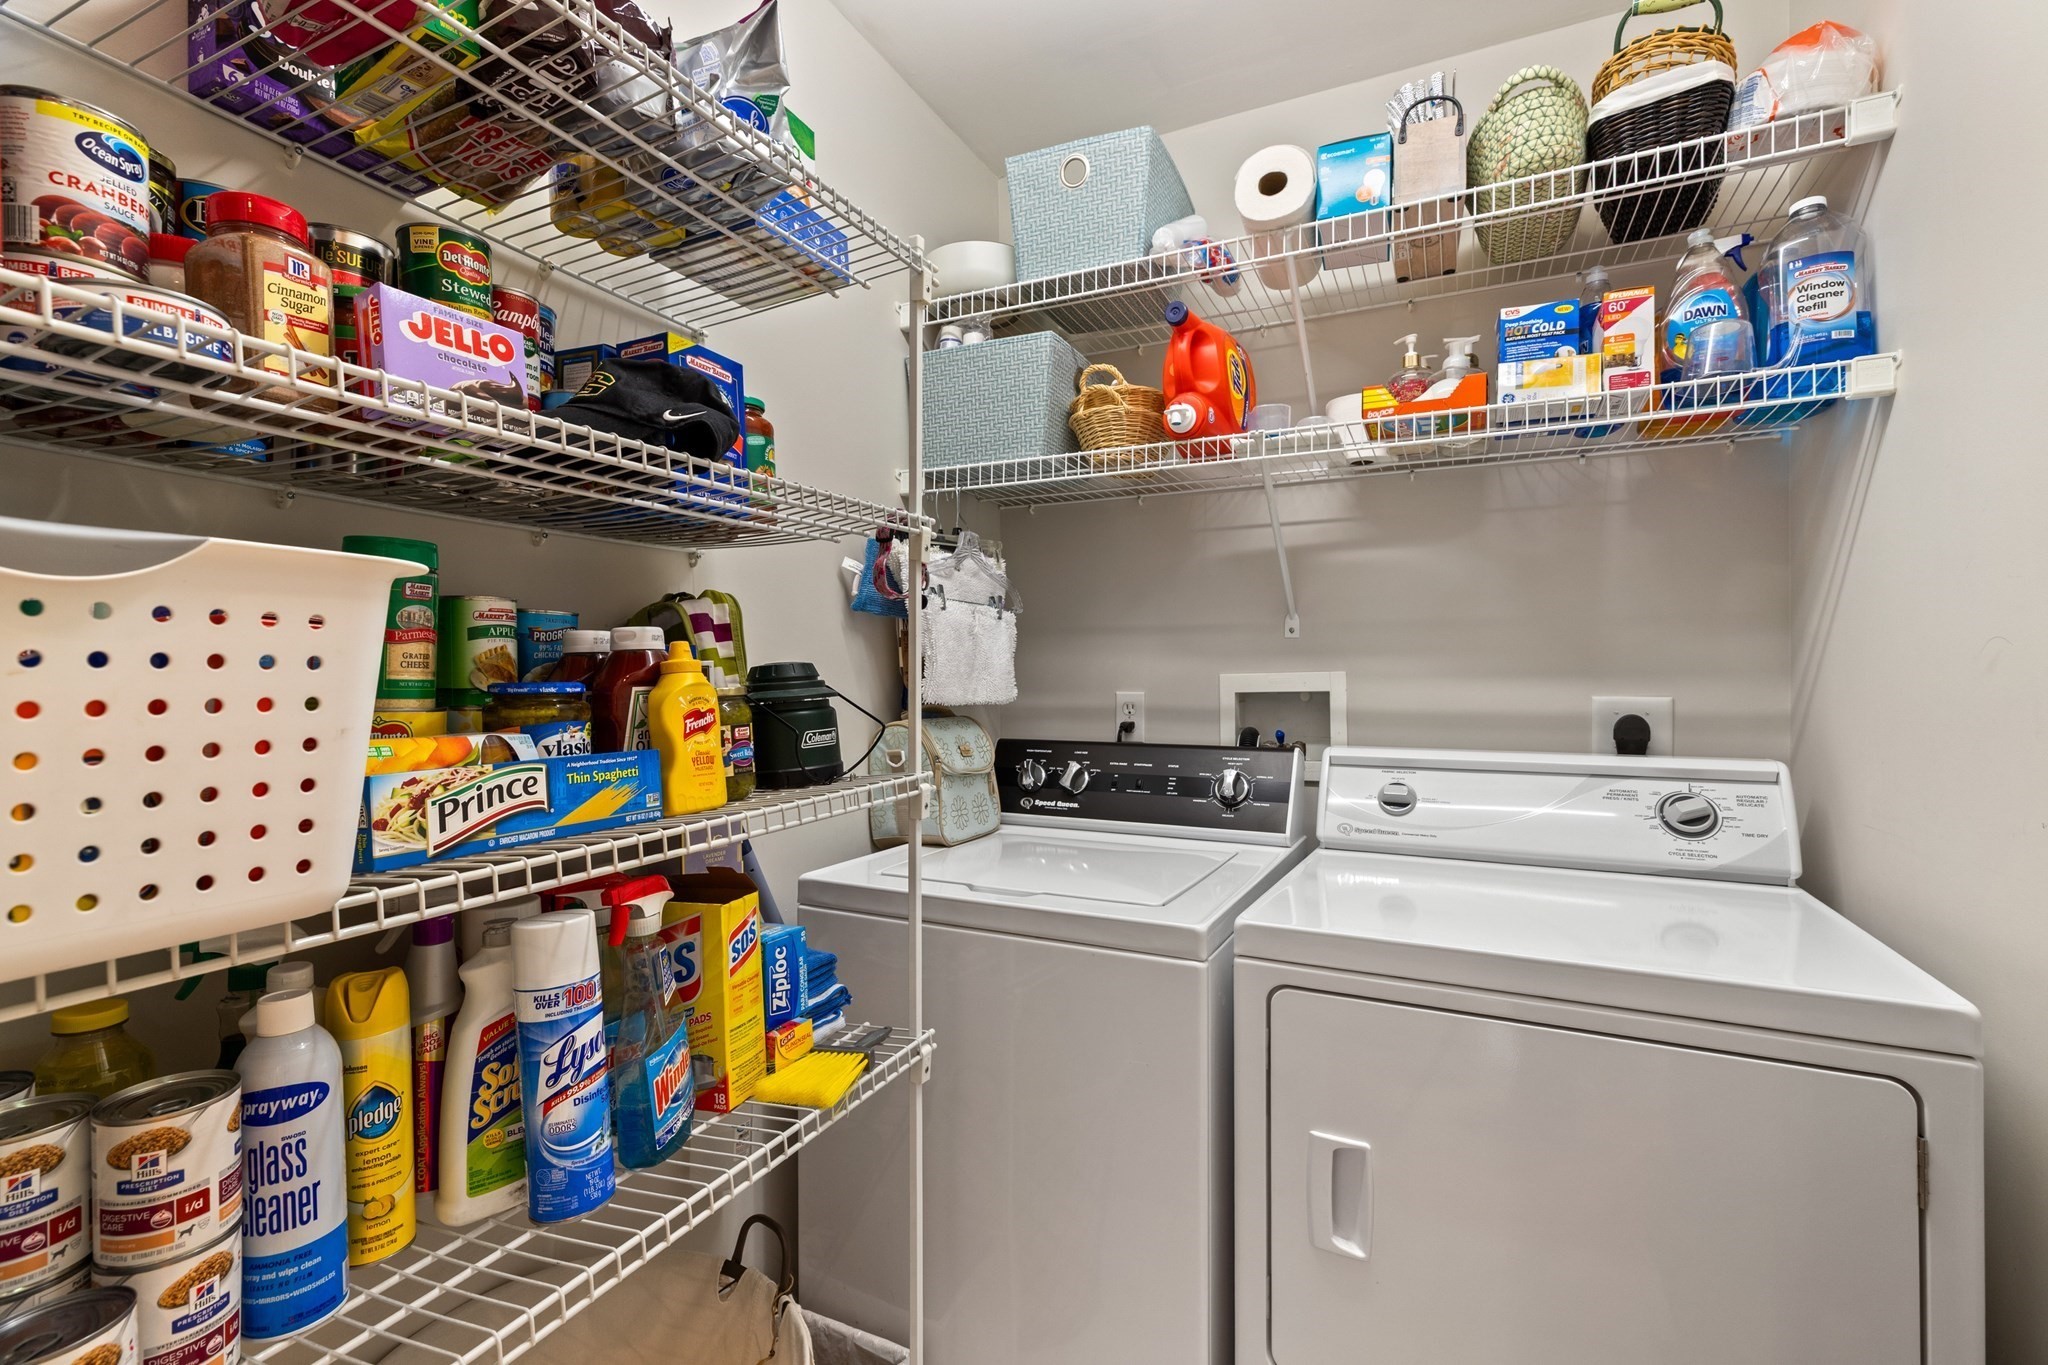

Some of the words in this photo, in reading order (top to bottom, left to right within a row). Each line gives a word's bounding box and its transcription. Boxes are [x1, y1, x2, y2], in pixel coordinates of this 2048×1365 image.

[73, 112, 90, 122] TRY
[93, 119, 122, 136] RECIPE
[82, 138, 119, 167] Ocean
[119, 156, 143, 178] Spray
[1327, 148, 1355, 158] ecosmart
[100, 175, 137, 197] JELLIED
[104, 202, 135, 221] SAUCE
[322, 246, 334, 260] le
[337, 250, 383, 276] SUEUR
[442, 250, 462, 264] Del
[462, 254, 490, 277] Monte
[284, 272, 314, 288] McCormick
[1796, 268, 1823, 277] MARKET
[268, 282, 326, 306] Cinnamon
[442, 278, 492, 306] Stewed
[1609, 288, 1648, 300] SYLVANIA
[1797, 280, 1845, 294] Window
[1797, 290, 1844, 304] Cleaner
[280, 297, 315, 314] Sugar
[1505, 308, 1520, 316] CVS
[1684, 304, 1728, 322] DAWN
[1797, 301, 1827, 314] Refill
[433, 307, 464, 323] FAMILY
[466, 318, 484, 330] SIZE
[1519, 318, 1544, 326] Soothing
[1505, 326, 1532, 336] HOT
[1532, 321, 1566, 333] COLD
[622, 348, 643, 357] MARKET
[644, 342, 663, 352] BASKET
[438, 352, 488, 373] chocolate
[688, 358, 712, 373] MARKET
[712, 366, 731, 381] BASKET
[1231, 354, 1244, 396] Tide
[1367, 407, 1394, 418] bounce
[476, 612, 504, 620] MARKET
[488, 628, 514, 636] APPLE
[402, 652, 430, 660] GRATED
[400, 660, 430, 669] CHEESE
[684, 712, 715, 734] French's
[807, 732, 832, 743] Coleman
[542, 739, 590, 757] vlasic
[571, 760, 598, 768] Neighborhood
[692, 756, 715, 766] YELLOW
[566, 772, 590, 784] Thin
[593, 766, 639, 784] Spaghetti
[438, 776, 538, 834] Prince
[1056, 800, 1078, 808] Queen
[500, 834, 518, 846] ENRICHED
[519, 832, 538, 842] MACARONI
[538, 828, 556, 838] PRODUCT
[703, 850, 726, 860] LAVENDER
[772, 946, 790, 1012] Ziploc
[533, 992, 560, 1004] KILLS
[562, 980, 596, 1008] 100
[535, 1000, 560, 1010] OVER
[545, 1008, 574, 1018] INCLUDING
[574, 1004, 584, 1012] THE
[689, 1012, 712, 1028] PADS
[424, 1031, 438, 1042] BIG
[484, 1021, 509, 1042] VALUE
[780, 1030, 796, 1047] GLAD
[416, 1043, 443, 1056] VALUE
[478, 1048, 494, 1062] Tough
[495, 1044, 502, 1052] on
[490, 1046, 508, 1060] Gentle
[418, 1062, 426, 1099] Always!
[551, 1094, 566, 1108] KILLS
[566, 1080, 591, 1098] 99.9%
[714, 1093, 726, 1104] 18
[243, 1088, 320, 1119] prayway
[348, 1096, 402, 1141] pledge
[548, 1118, 576, 1128] ELIMINATES
[418, 1106, 426, 1154] Application
[549, 1122, 577, 1136] ODORS
[355, 1147, 380, 1158] expert
[382, 1141, 396, 1150] care
[248, 1138, 308, 1194] glass
[352, 1162, 384, 1173] enhancing
[385, 1154, 402, 1166] polish
[362, 1152, 392, 1166] lemon
[137, 1168, 162, 1180] Hill's
[418, 1157, 426, 1180] COAT
[586, 1172, 594, 1180] NET
[121, 1174, 180, 1190] PRESCRIPTION
[352, 1182, 370, 1190] SHINES
[376, 1170, 402, 1184] PROTECTS
[6, 1190, 34, 1204] Hill's
[104, 1198, 146, 1207] VETERINARIAN
[148, 1184, 202, 1202] RECOMMENDED
[140, 1185, 158, 1194] DIET
[8, 1207, 32, 1218] DIET
[17, 1201, 75, 1225] RECOMMENDED
[184, 1198, 204, 1214] i/d
[242, 1180, 320, 1238] cleaner
[102, 1211, 150, 1222] DIGESTIVE
[366, 1218, 390, 1230] lemon
[58, 1220, 76, 1234] i/d
[102, 1223, 124, 1232] CARE
[249, 1258, 291, 1270] AMMONIA
[294, 1249, 312, 1260] FREE
[262, 1272, 276, 1280] and
[278, 1266, 298, 1278] wipe
[300, 1256, 322, 1270] clean
[250, 1284, 274, 1292] LEAVES
[278, 1280, 290, 1288] NO
[294, 1271, 312, 1282] FILM
[194, 1295, 216, 1310] Hill's
[177, 1296, 228, 1328] PRESCRIPTION
[196, 1311, 214, 1324] DIET
[149, 1338, 206, 1365] DIGESTIVE
